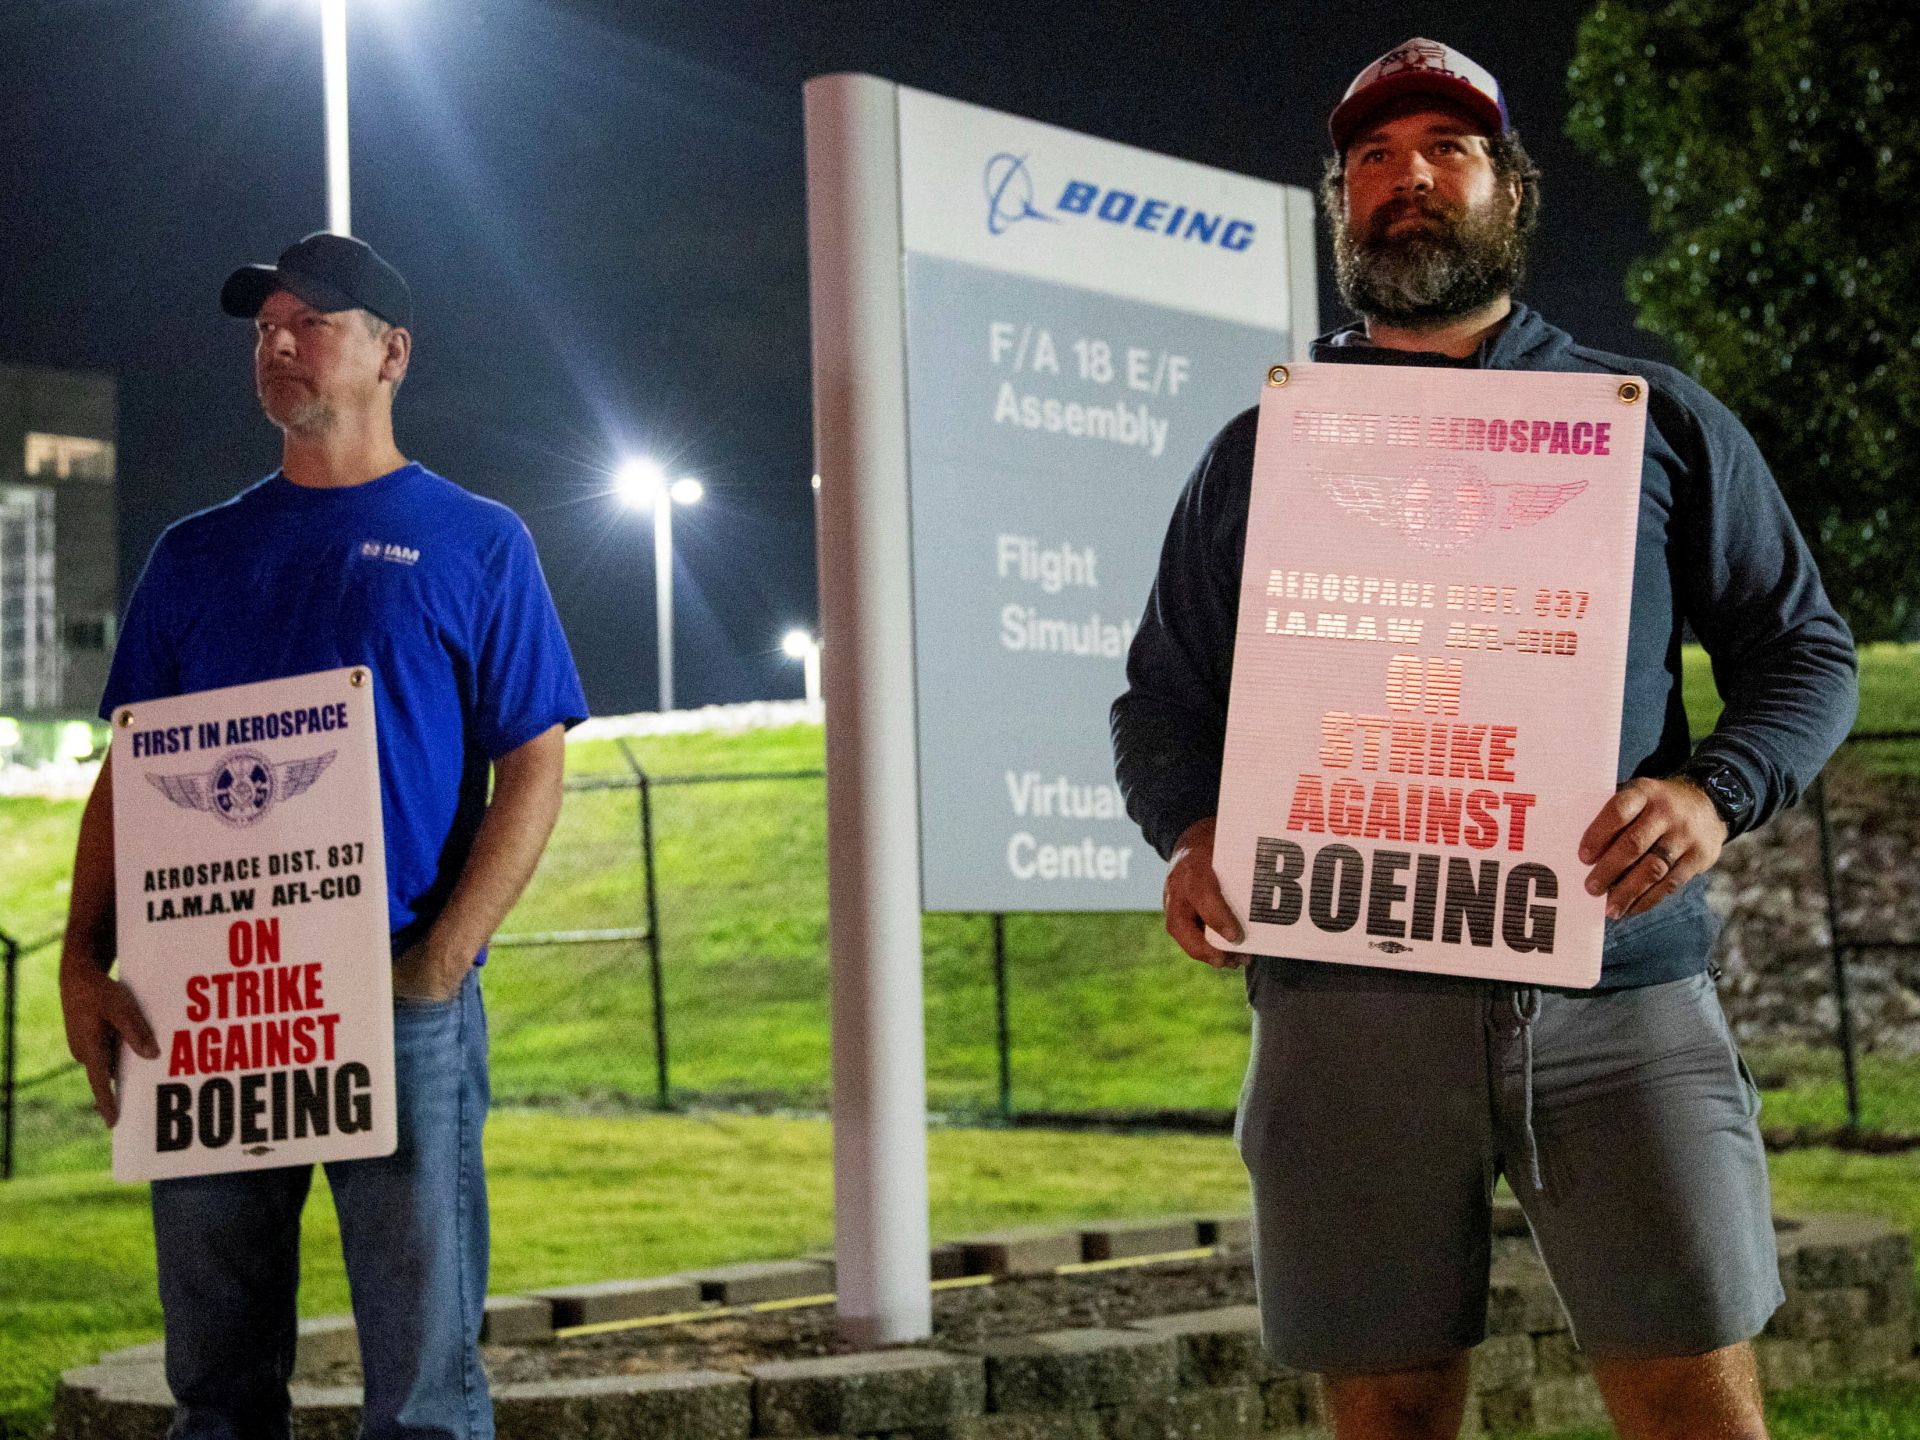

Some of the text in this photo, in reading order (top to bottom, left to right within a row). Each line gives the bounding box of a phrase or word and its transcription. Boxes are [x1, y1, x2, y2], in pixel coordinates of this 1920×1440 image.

[1056, 180, 1256, 251] BOEING
[989, 321, 1191, 396] F/A 18 E/F
[995, 381, 1169, 458] Assembly
[1293, 410, 1612, 457] FIRST IN AEROSPACE
[385, 543, 420, 562] IAM
[997, 533, 1097, 594] Flight
[1266, 569, 1590, 620] AEROSPACE DIST. 837
[1001, 603, 1141, 658] Simulat
[1265, 608, 1578, 656] I.A.M.A.W AFL-CIO
[1385, 653, 1463, 716] ON
[132, 702, 348, 758] FIRST IN AEROSPACE
[1318, 710, 1518, 783] STRIKE
[1286, 773, 1537, 852] AGAINST
[144, 842, 364, 892] AEROSPACE DIST. 837
[1007, 831, 1133, 881] Center
[147, 874, 361, 922] I.A.M.A.W AFL-CIO
[1248, 836, 1559, 954] BOEING
[228, 917, 281, 967] ON
[186, 962, 324, 1022] STRIKE
[168, 1013, 340, 1077] AGAINST
[156, 1061, 372, 1152] BOEING
